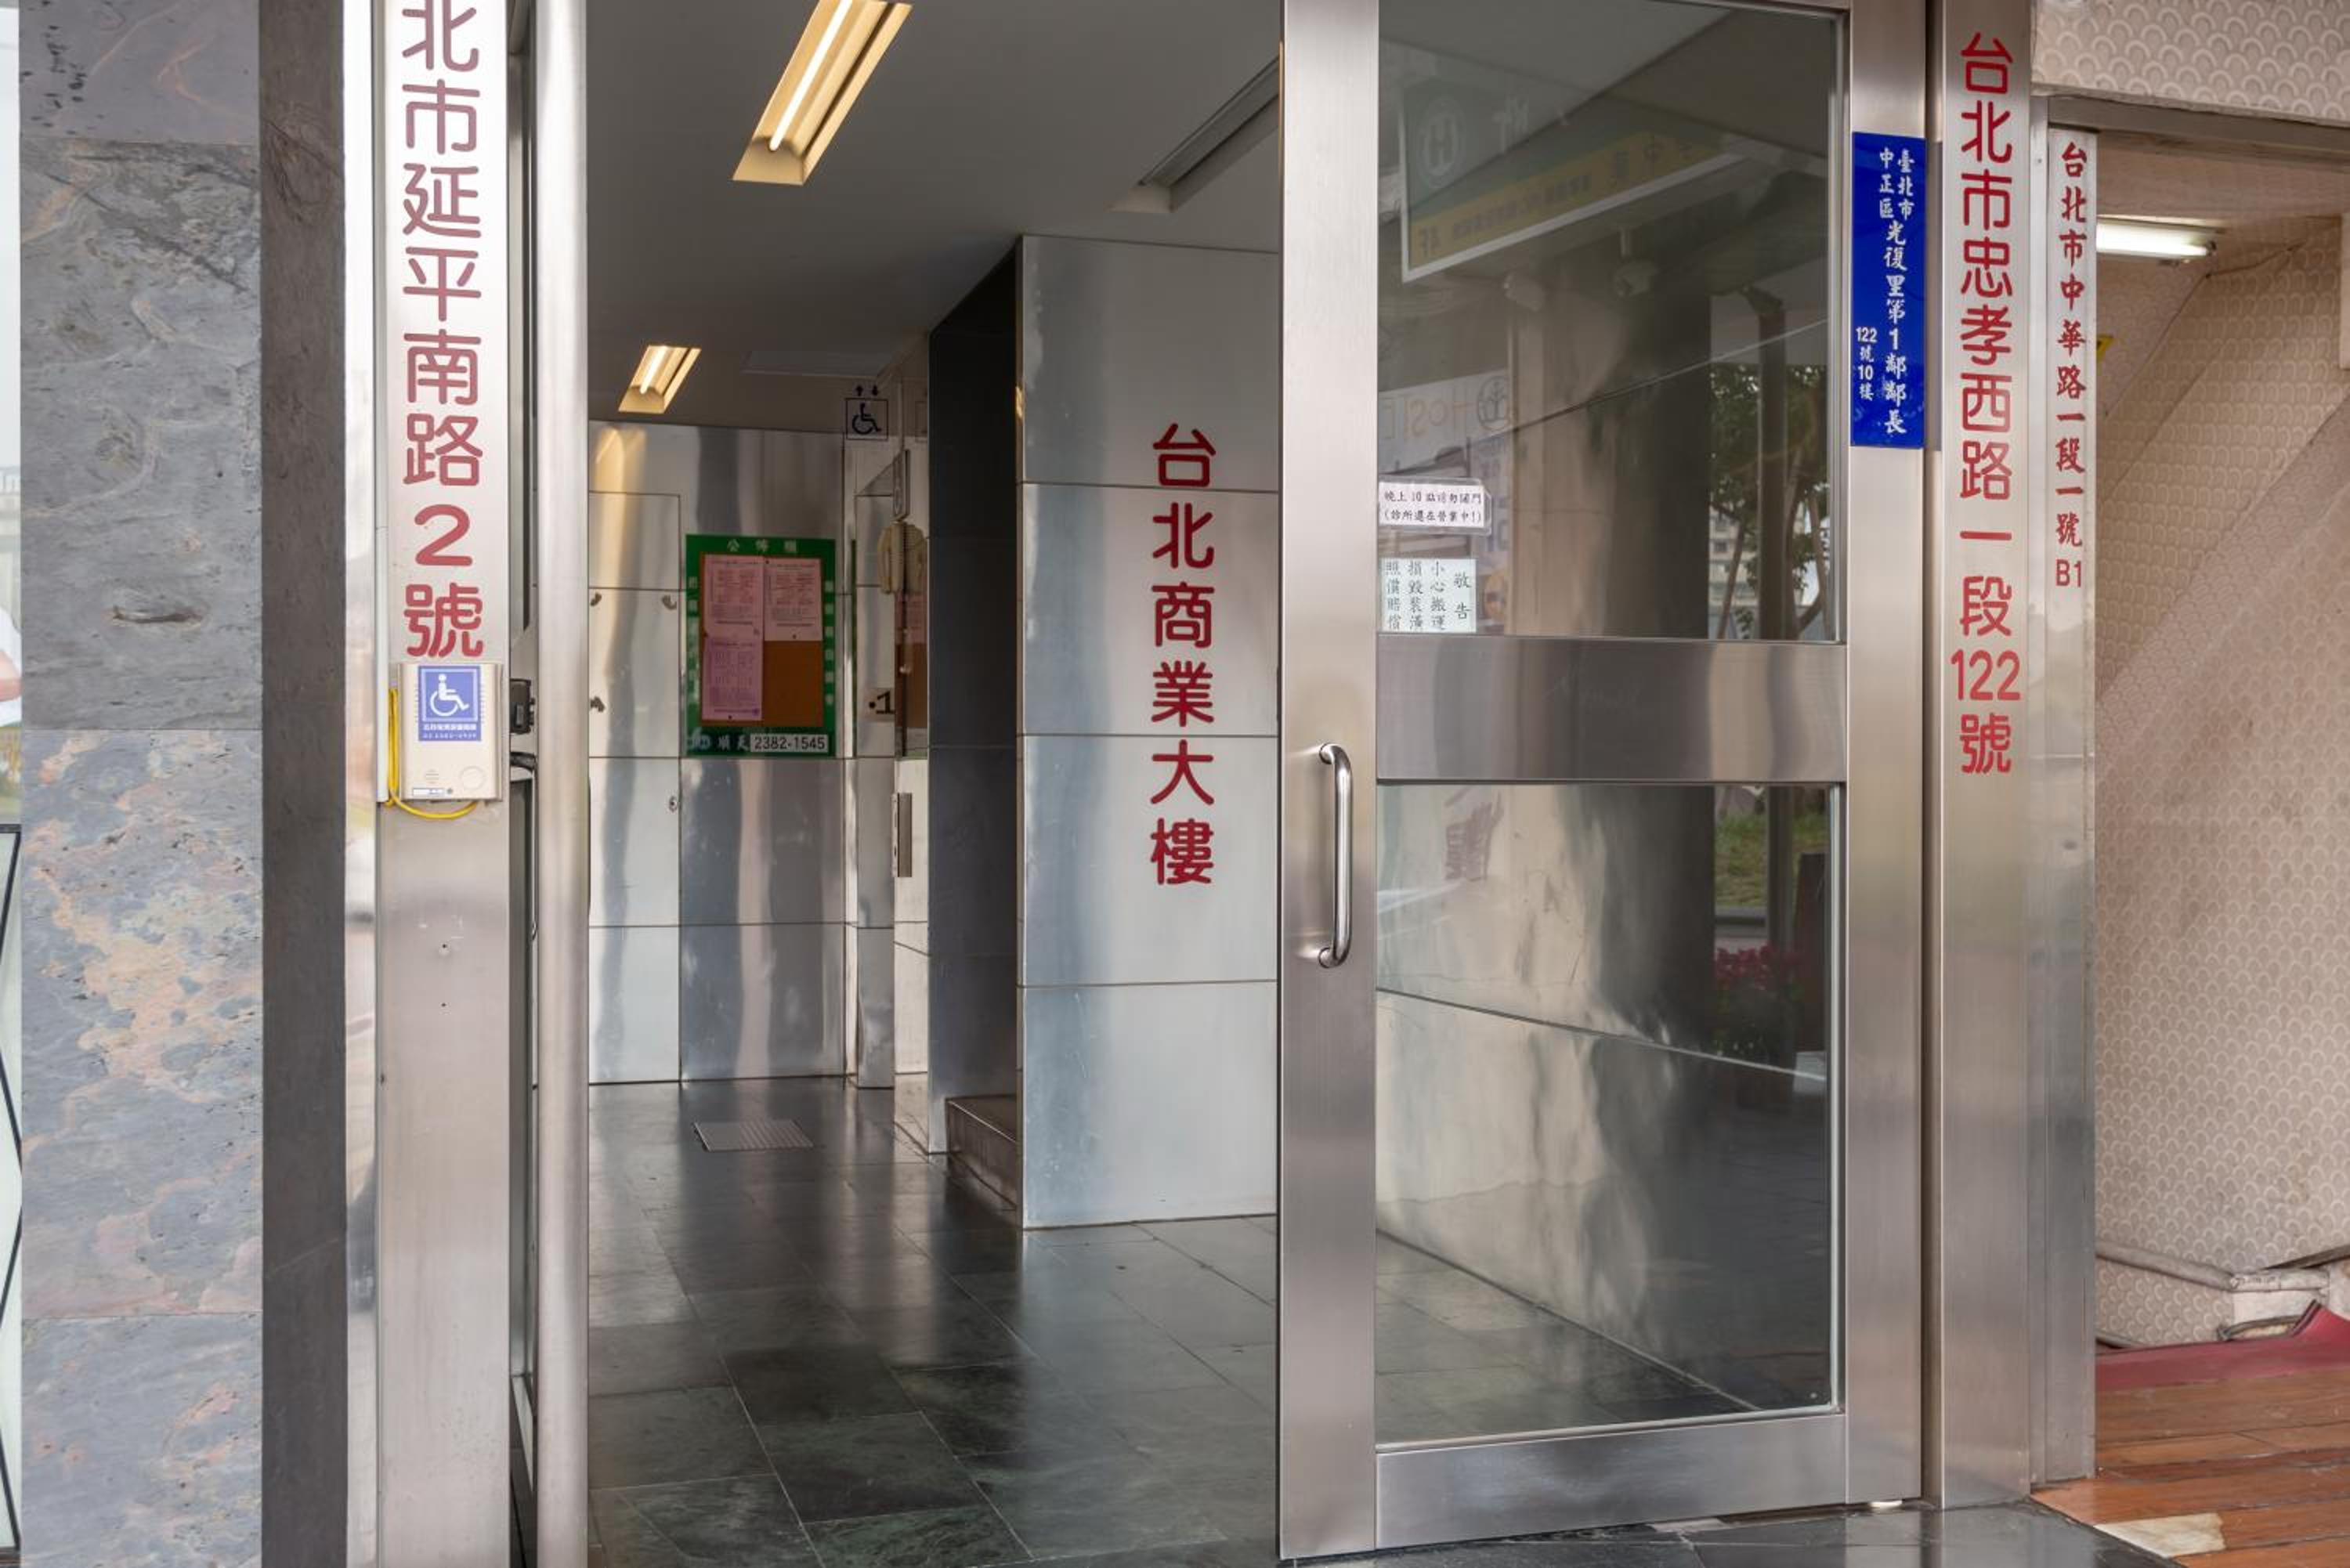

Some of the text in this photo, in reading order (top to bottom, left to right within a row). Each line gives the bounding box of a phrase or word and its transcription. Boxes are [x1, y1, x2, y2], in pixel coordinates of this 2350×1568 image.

[1950, 31, 2024, 776] 台北市忠孝西路一段122號
[1151, 423, 1218, 887] 台北商業大樓
[1454, 571, 1472, 620] 敬告
[754, 736, 826, 750] 2382-1545
